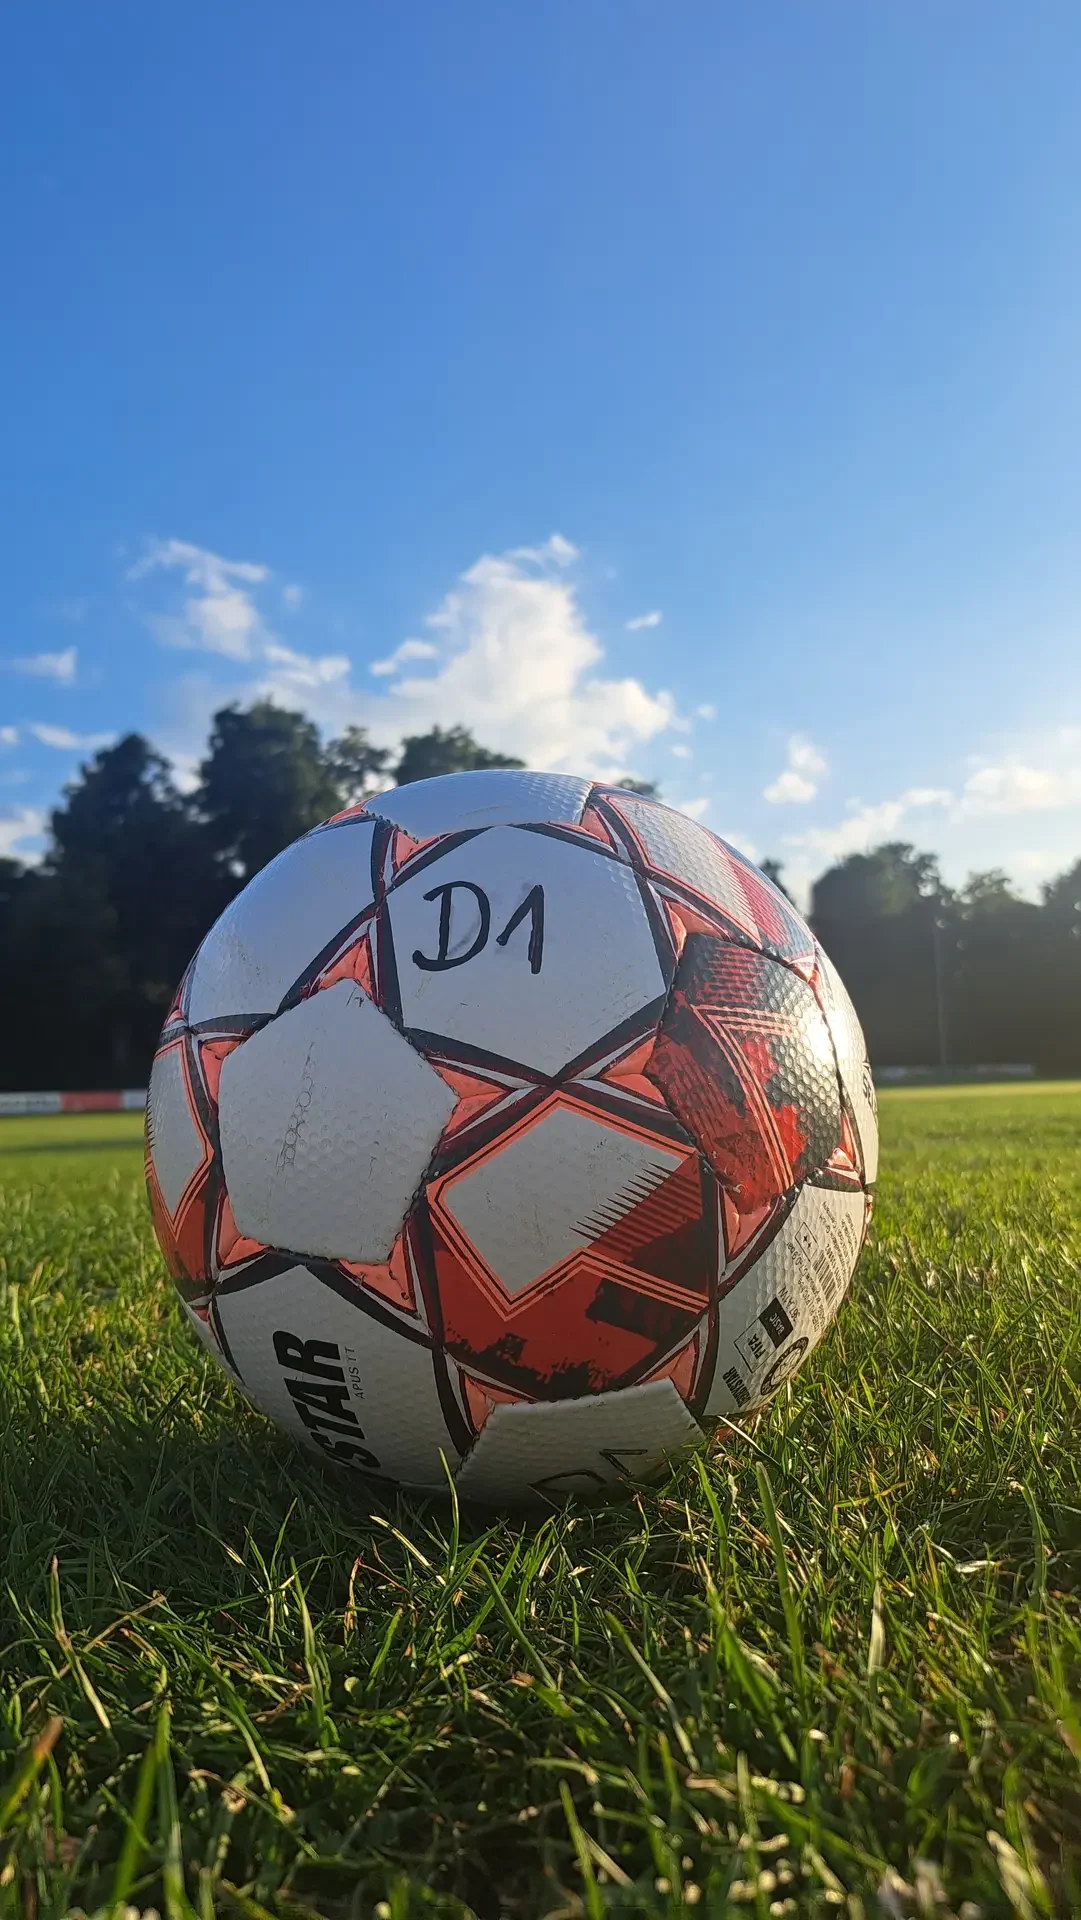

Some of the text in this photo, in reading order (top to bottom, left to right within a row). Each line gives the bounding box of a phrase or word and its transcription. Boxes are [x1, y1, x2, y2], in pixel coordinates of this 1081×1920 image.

[412, 880, 545, 975] D1
[768, 1312, 785, 1337] BASIC
[747, 1333, 767, 1360] FIFA
